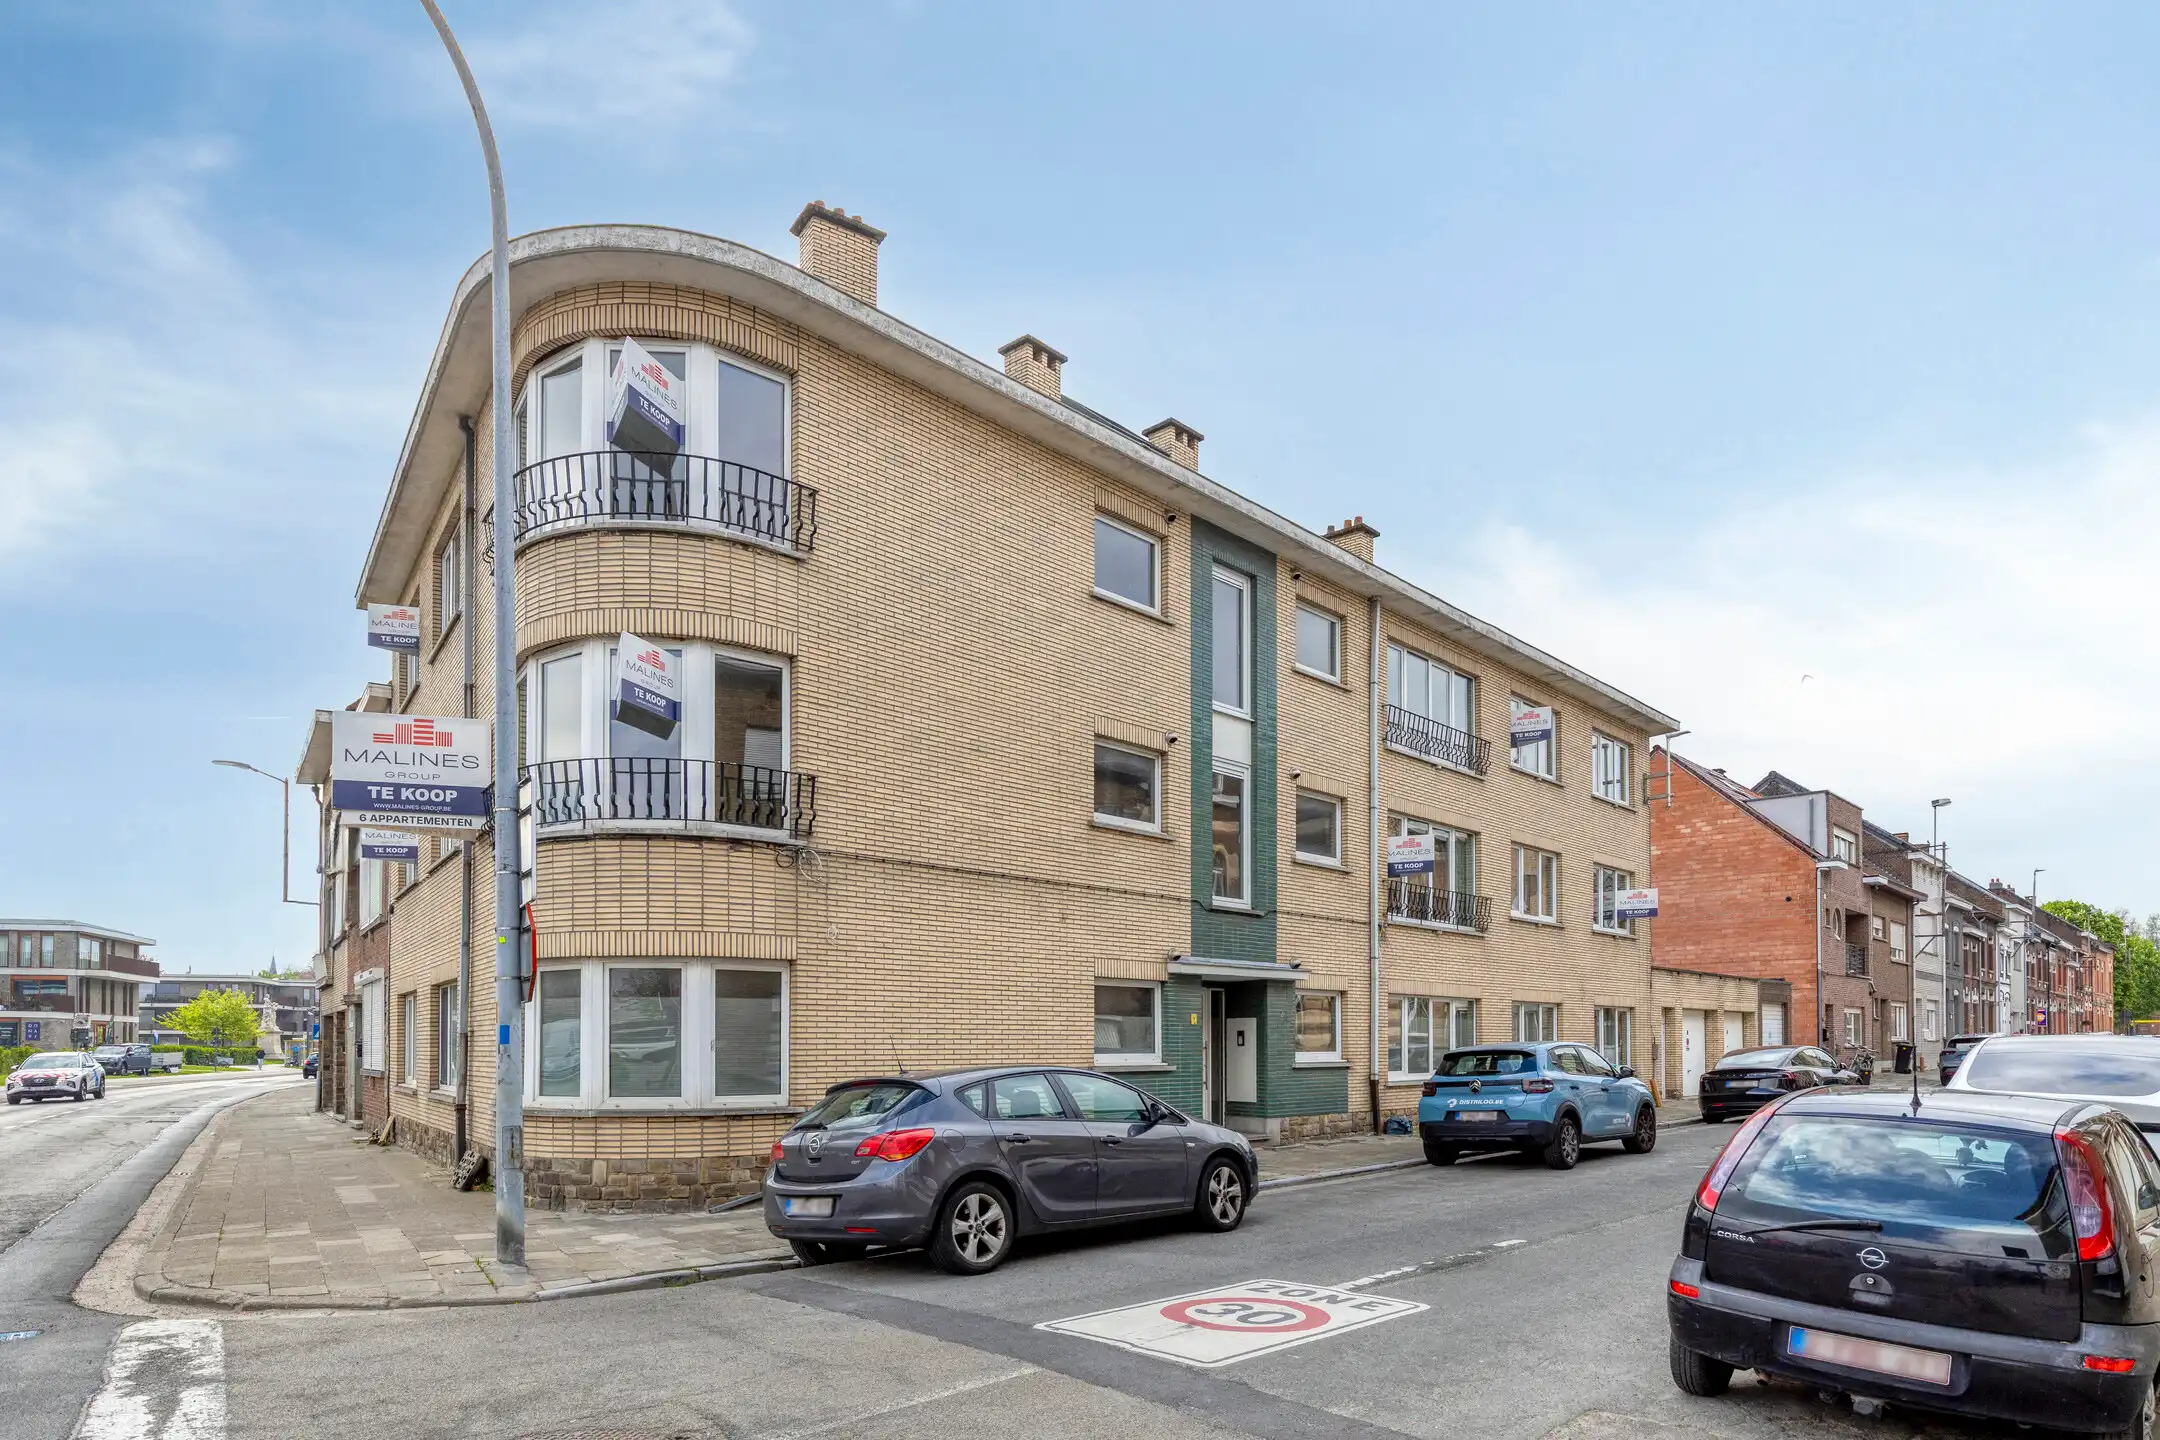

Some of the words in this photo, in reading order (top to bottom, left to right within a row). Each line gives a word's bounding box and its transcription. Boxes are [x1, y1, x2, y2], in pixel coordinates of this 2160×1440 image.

[631, 366, 678, 410] MALINES
[639, 396, 649, 410] TE
[650, 405, 671, 426] KOOP
[371, 619, 420, 629] MALINE
[393, 636, 417, 644] KOOP
[626, 659, 674, 688] MALINES
[633, 687, 645, 699] TE
[645, 692, 667, 708] KOOP
[1510, 719, 1549, 728] MALINES
[344, 748, 480, 769] MALINES
[384, 771, 441, 781] GROUP
[367, 785, 394, 800] TE
[400, 787, 458, 803] KOOP
[373, 802, 452, 812] WWW.MALINES-GROUP.BE
[359, 813, 367, 822] 6
[370, 814, 473, 827] APPARTEMENTEN
[365, 832, 417, 840] MALINES
[1386, 849, 1431, 857] MALINES
[1717, 1230, 1755, 1244] CORSA
[1245, 1283, 1393, 1313] ZONE
[1195, 1303, 1298, 1327] 30
